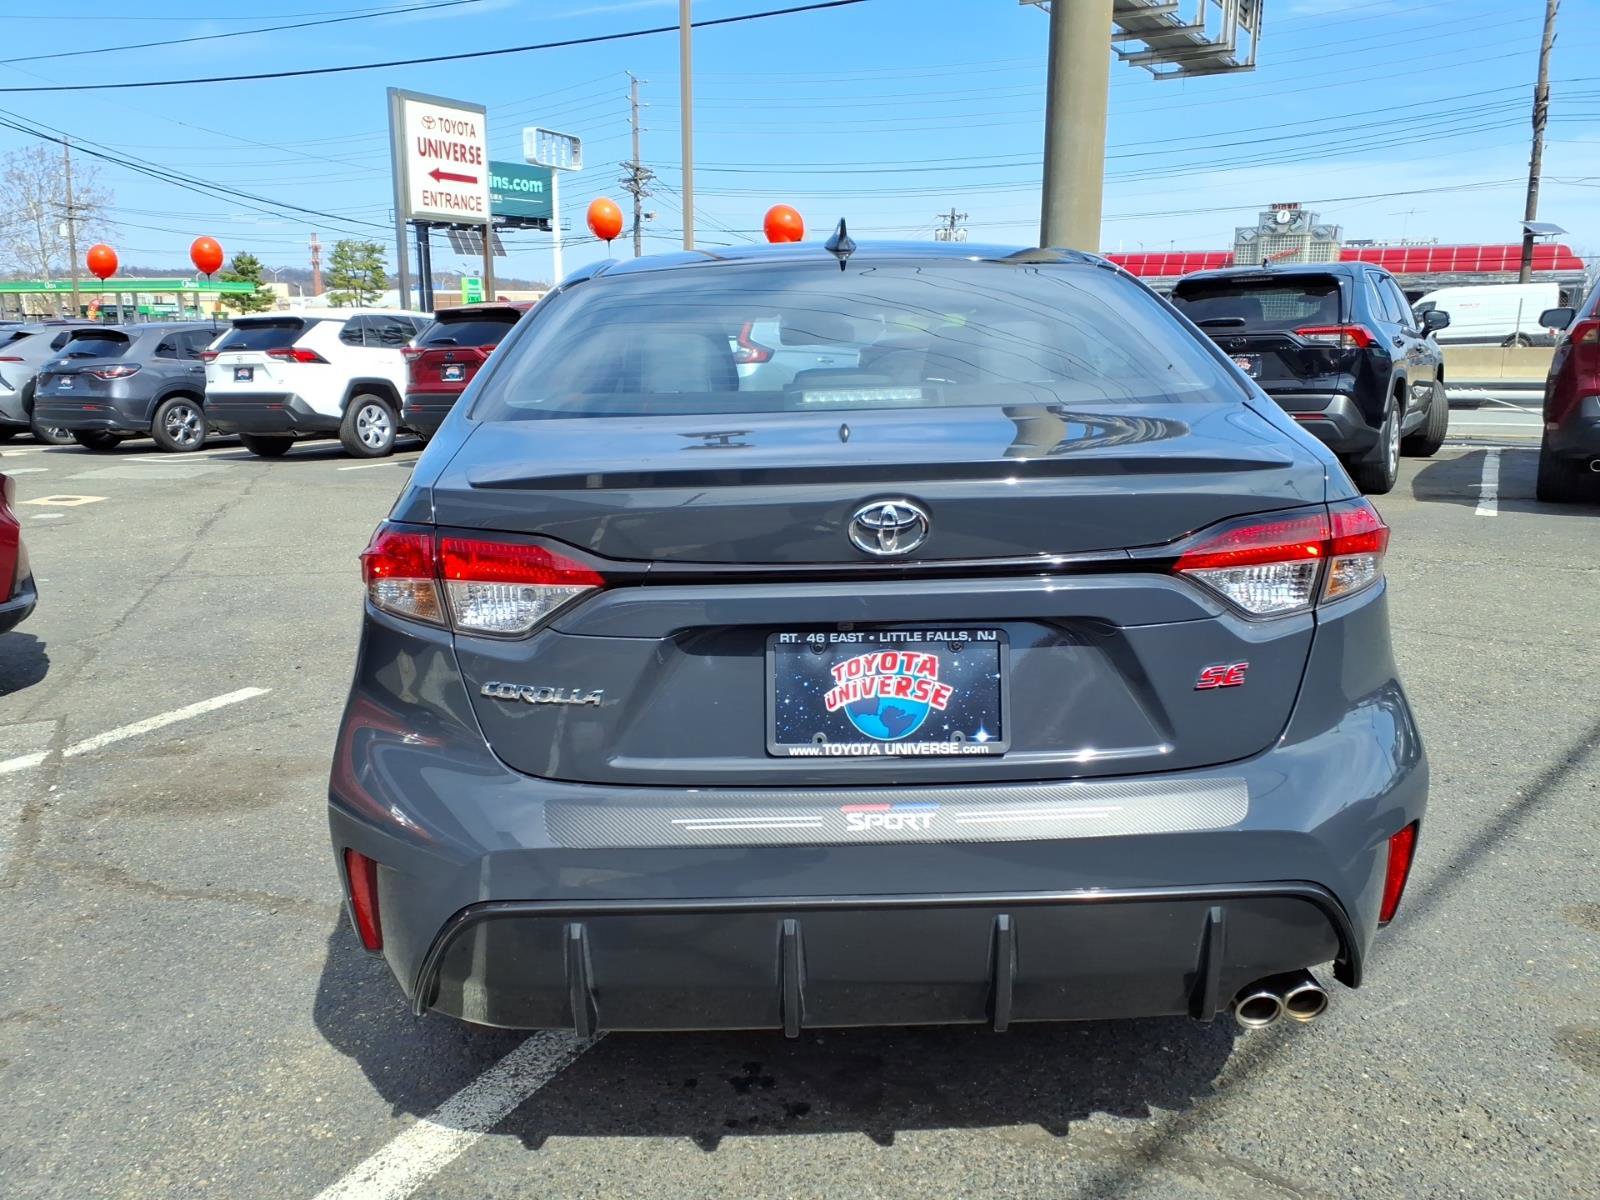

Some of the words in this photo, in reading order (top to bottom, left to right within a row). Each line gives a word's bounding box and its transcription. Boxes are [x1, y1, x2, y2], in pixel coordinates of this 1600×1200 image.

[438, 117, 476, 138] TOYOTA
[417, 137, 482, 165] UNIVERSE
[422, 190, 483, 212] ENTRANCE
[780, 633, 801, 643] RT.
[807, 633, 825, 643] 46
[829, 632, 865, 643] EAST
[879, 632, 922, 642] LITTLE
[926, 631, 972, 643] FALLS,
[977, 631, 997, 641] NJ
[831, 651, 939, 684] TOYOTA
[1195, 662, 1250, 690] SE
[481, 681, 604, 706] COROLLA
[824, 675, 954, 712] UNIVERSE
[885, 742, 989, 755] UNIVERSE.com
[846, 812, 936, 832] SPORT
